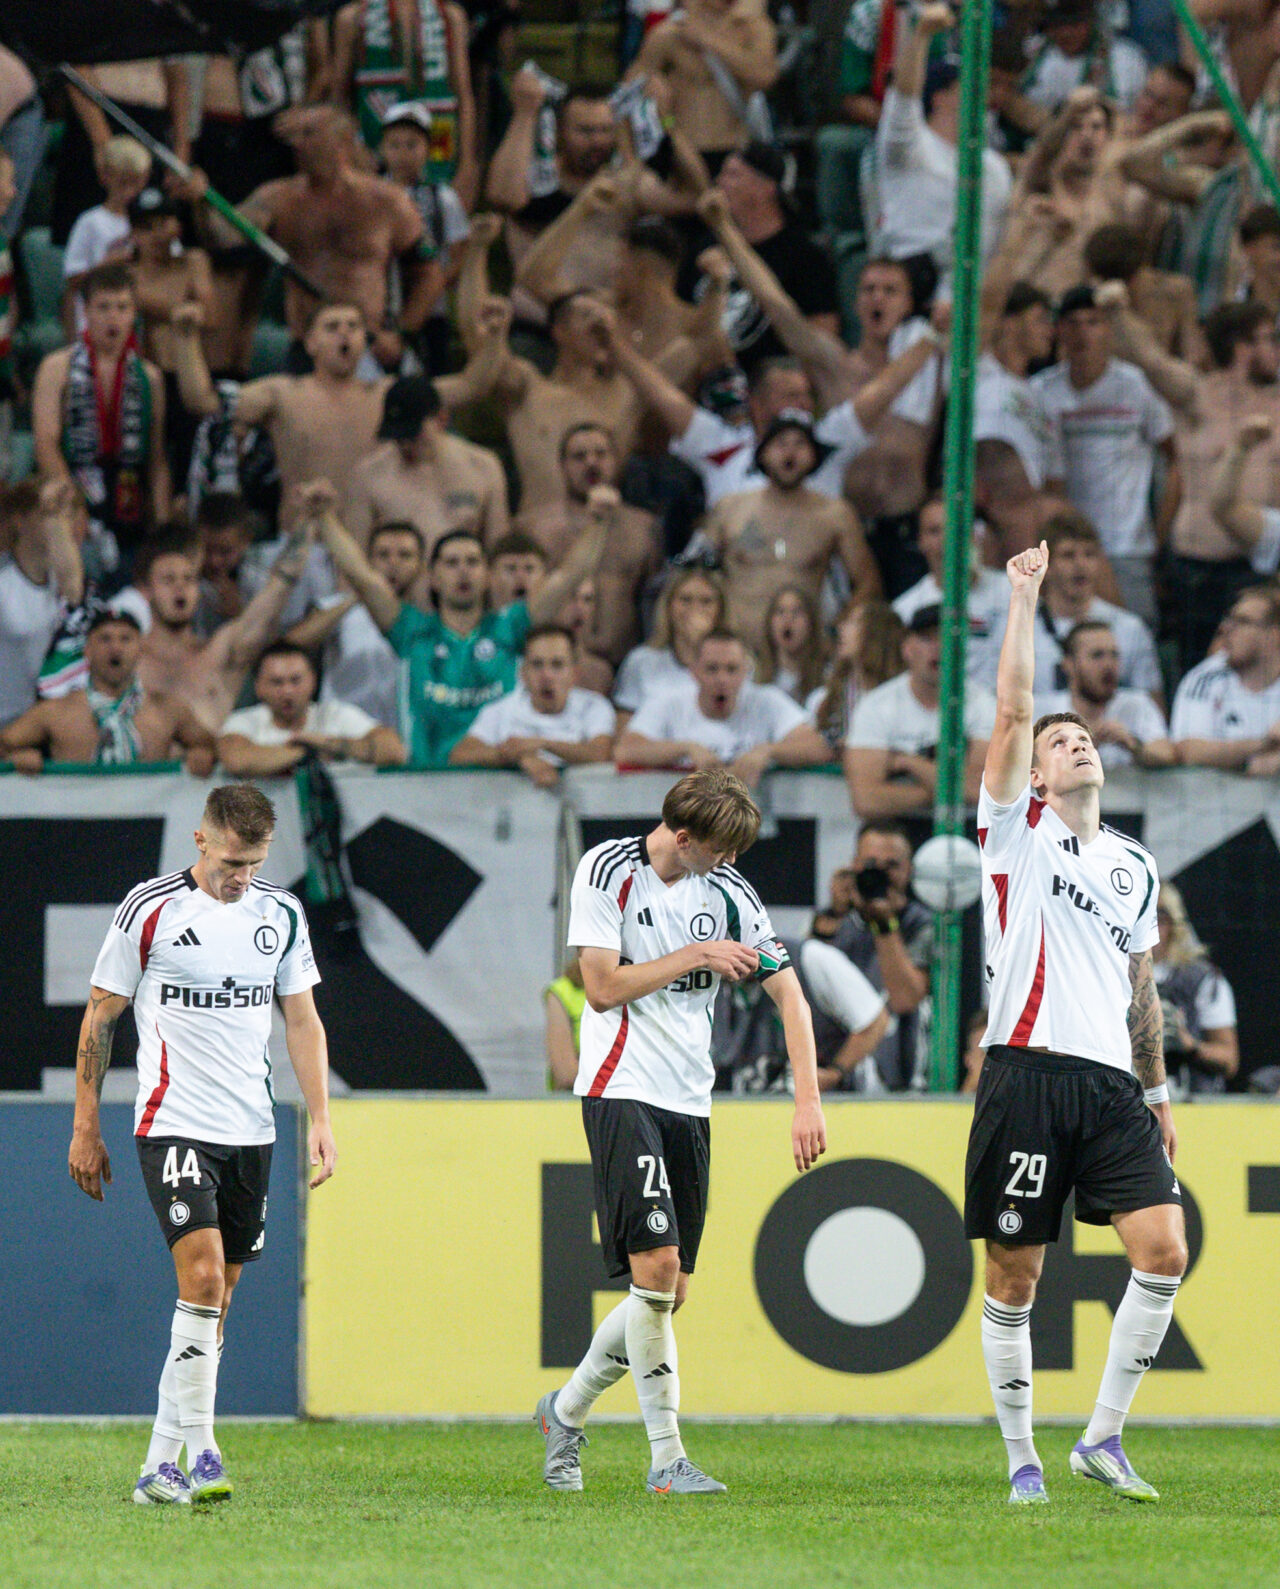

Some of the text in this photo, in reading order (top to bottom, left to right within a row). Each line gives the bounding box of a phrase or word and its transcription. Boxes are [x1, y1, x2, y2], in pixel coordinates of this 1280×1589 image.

[160, 983, 272, 1009] Plus500
[162, 1146, 202, 1188] 44
[637, 1155, 671, 1198] 24
[1004, 1151, 1048, 1198] 29
